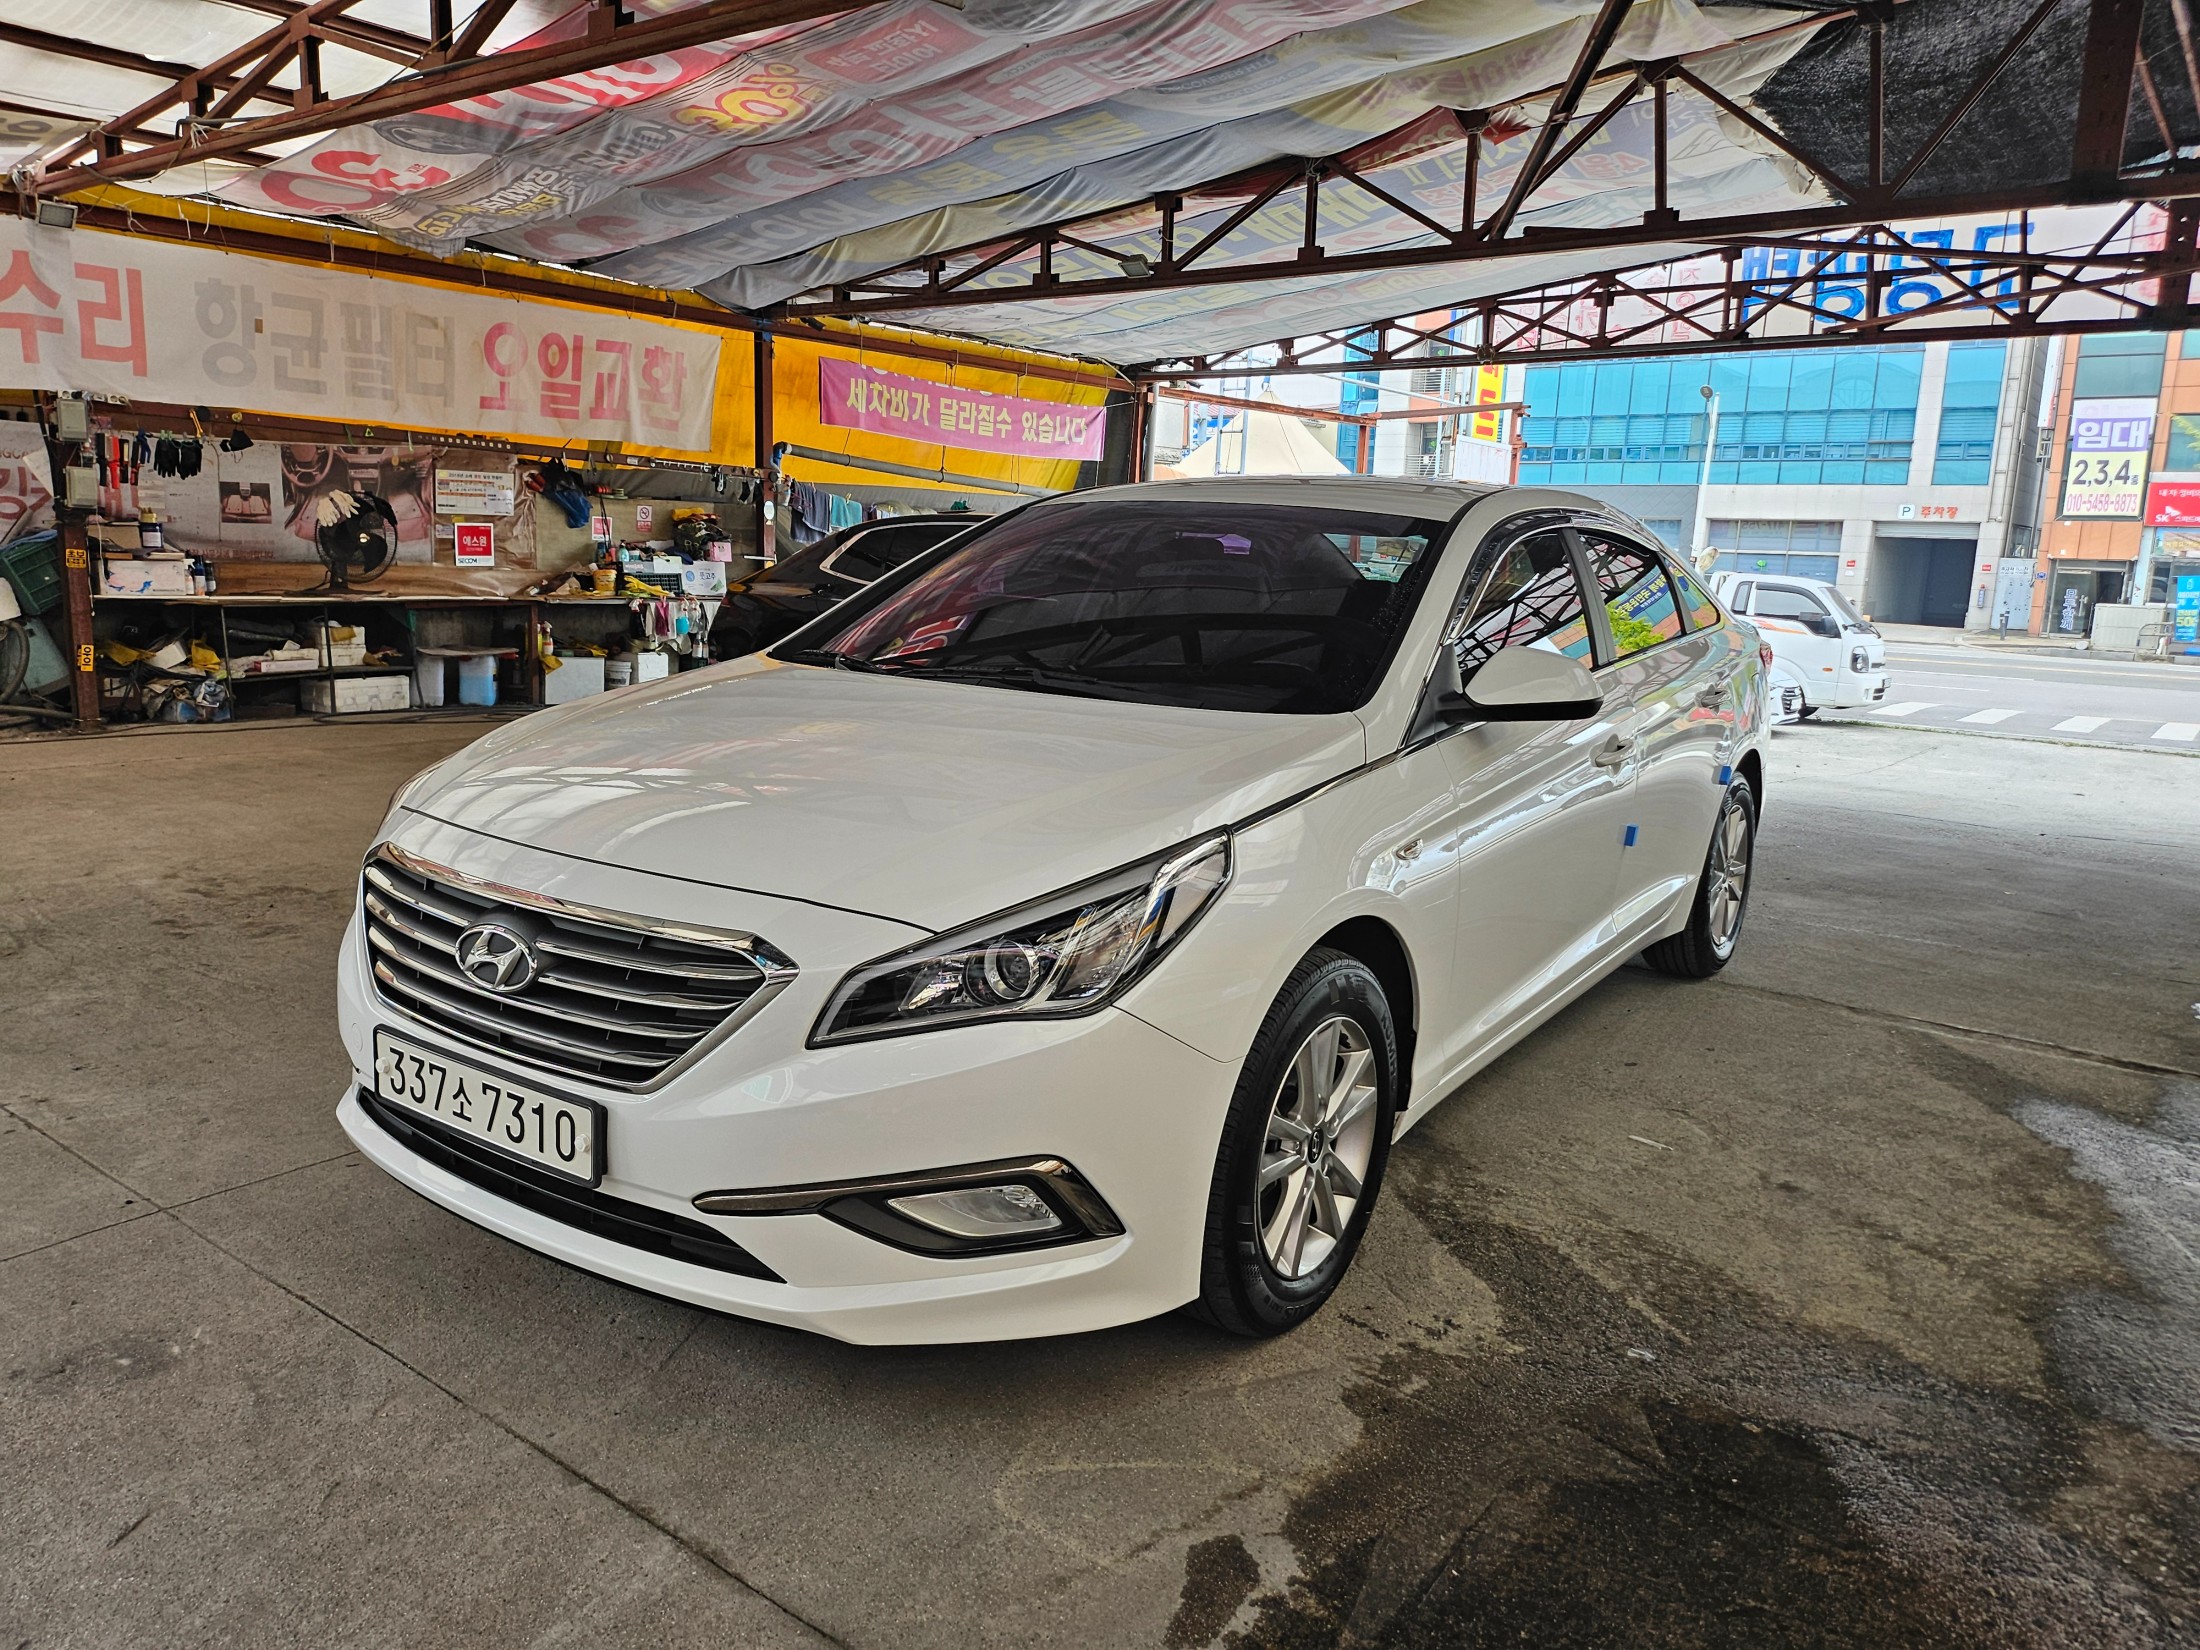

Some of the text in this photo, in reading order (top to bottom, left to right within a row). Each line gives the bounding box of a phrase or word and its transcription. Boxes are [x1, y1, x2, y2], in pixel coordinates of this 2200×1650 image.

[0, 249, 147, 378] 수리
[195, 276, 457, 408] 항균필터
[478, 321, 688, 433] 오일교환
[846, 376, 931, 427] 세차비가
[939, 396, 1012, 440] 달라질수
[1021, 415, 1088, 446] 있습니다
[2077, 419, 2148, 449] 임대
[1920, 504, 1959, 519] 주차장
[2066, 492, 2138, 513] 010-5458-8873
[2155, 514, 2170, 523] SK
[462, 535, 487, 547] 에스원
[388, 1046, 576, 1163] 337소7310
